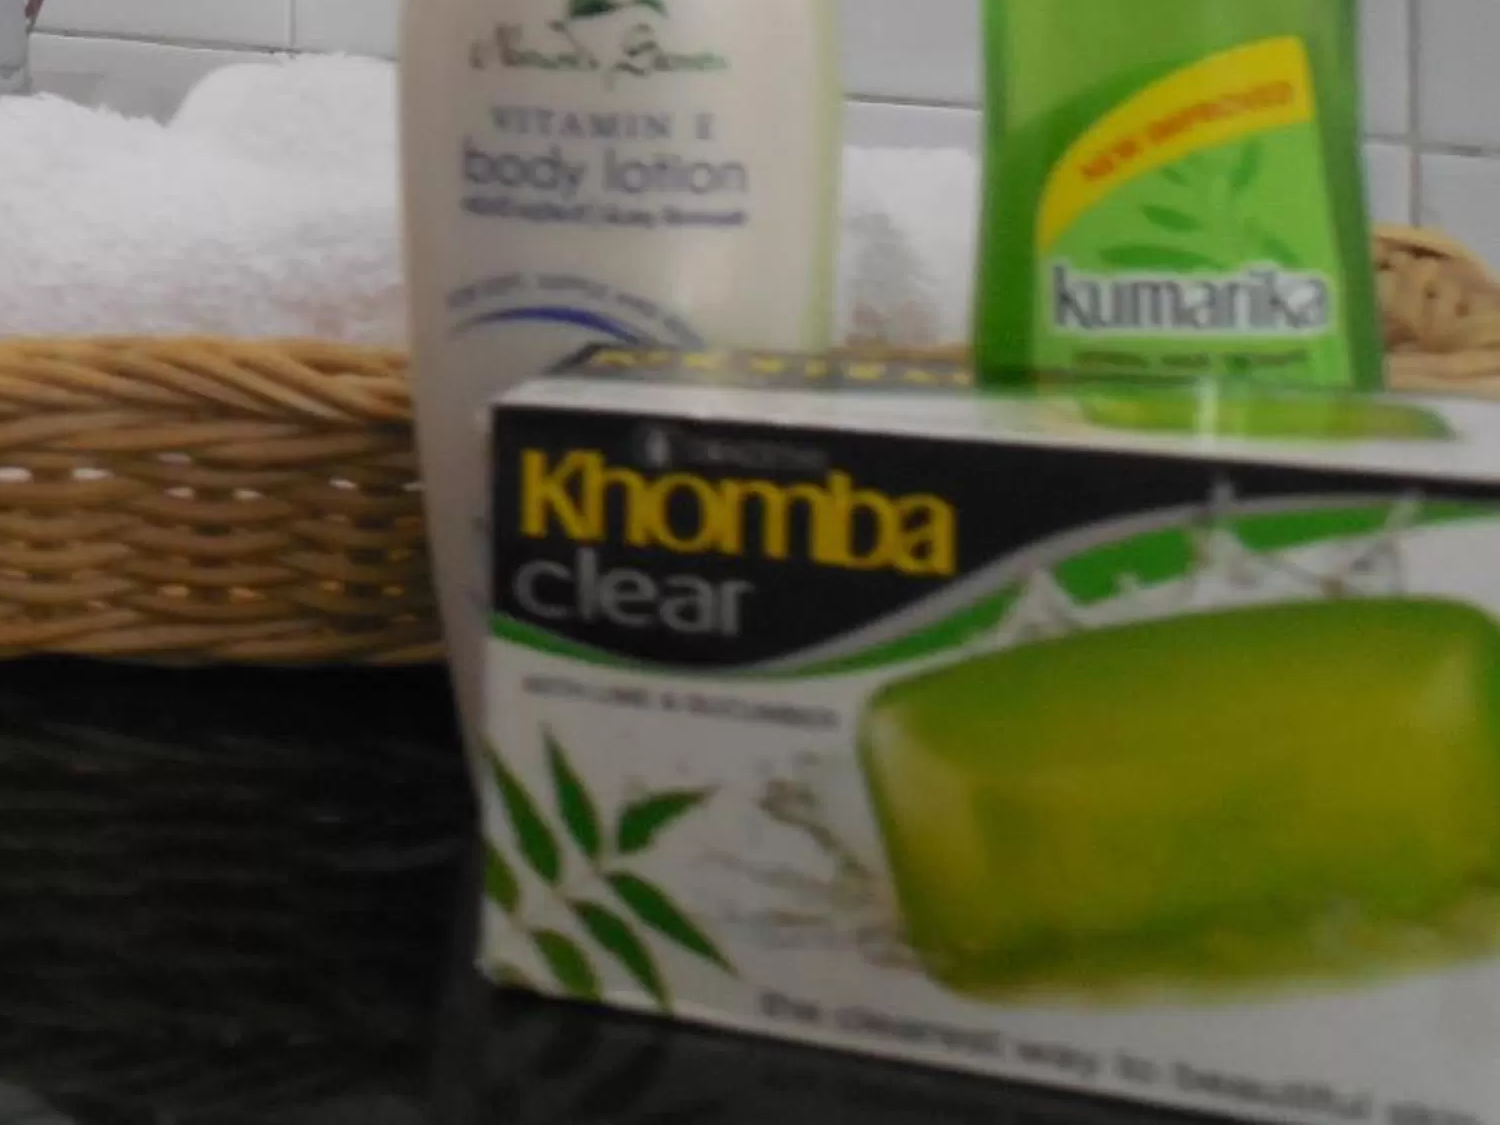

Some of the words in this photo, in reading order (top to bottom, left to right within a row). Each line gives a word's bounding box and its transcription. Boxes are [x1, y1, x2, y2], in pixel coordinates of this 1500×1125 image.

[490, 105, 672, 140] VITAMIN
[462, 135, 587, 195] body
[604, 147, 750, 194] lotion
[1053, 262, 1329, 330] kumarika
[519, 446, 957, 575] Khomba
[512, 547, 755, 637] clear
